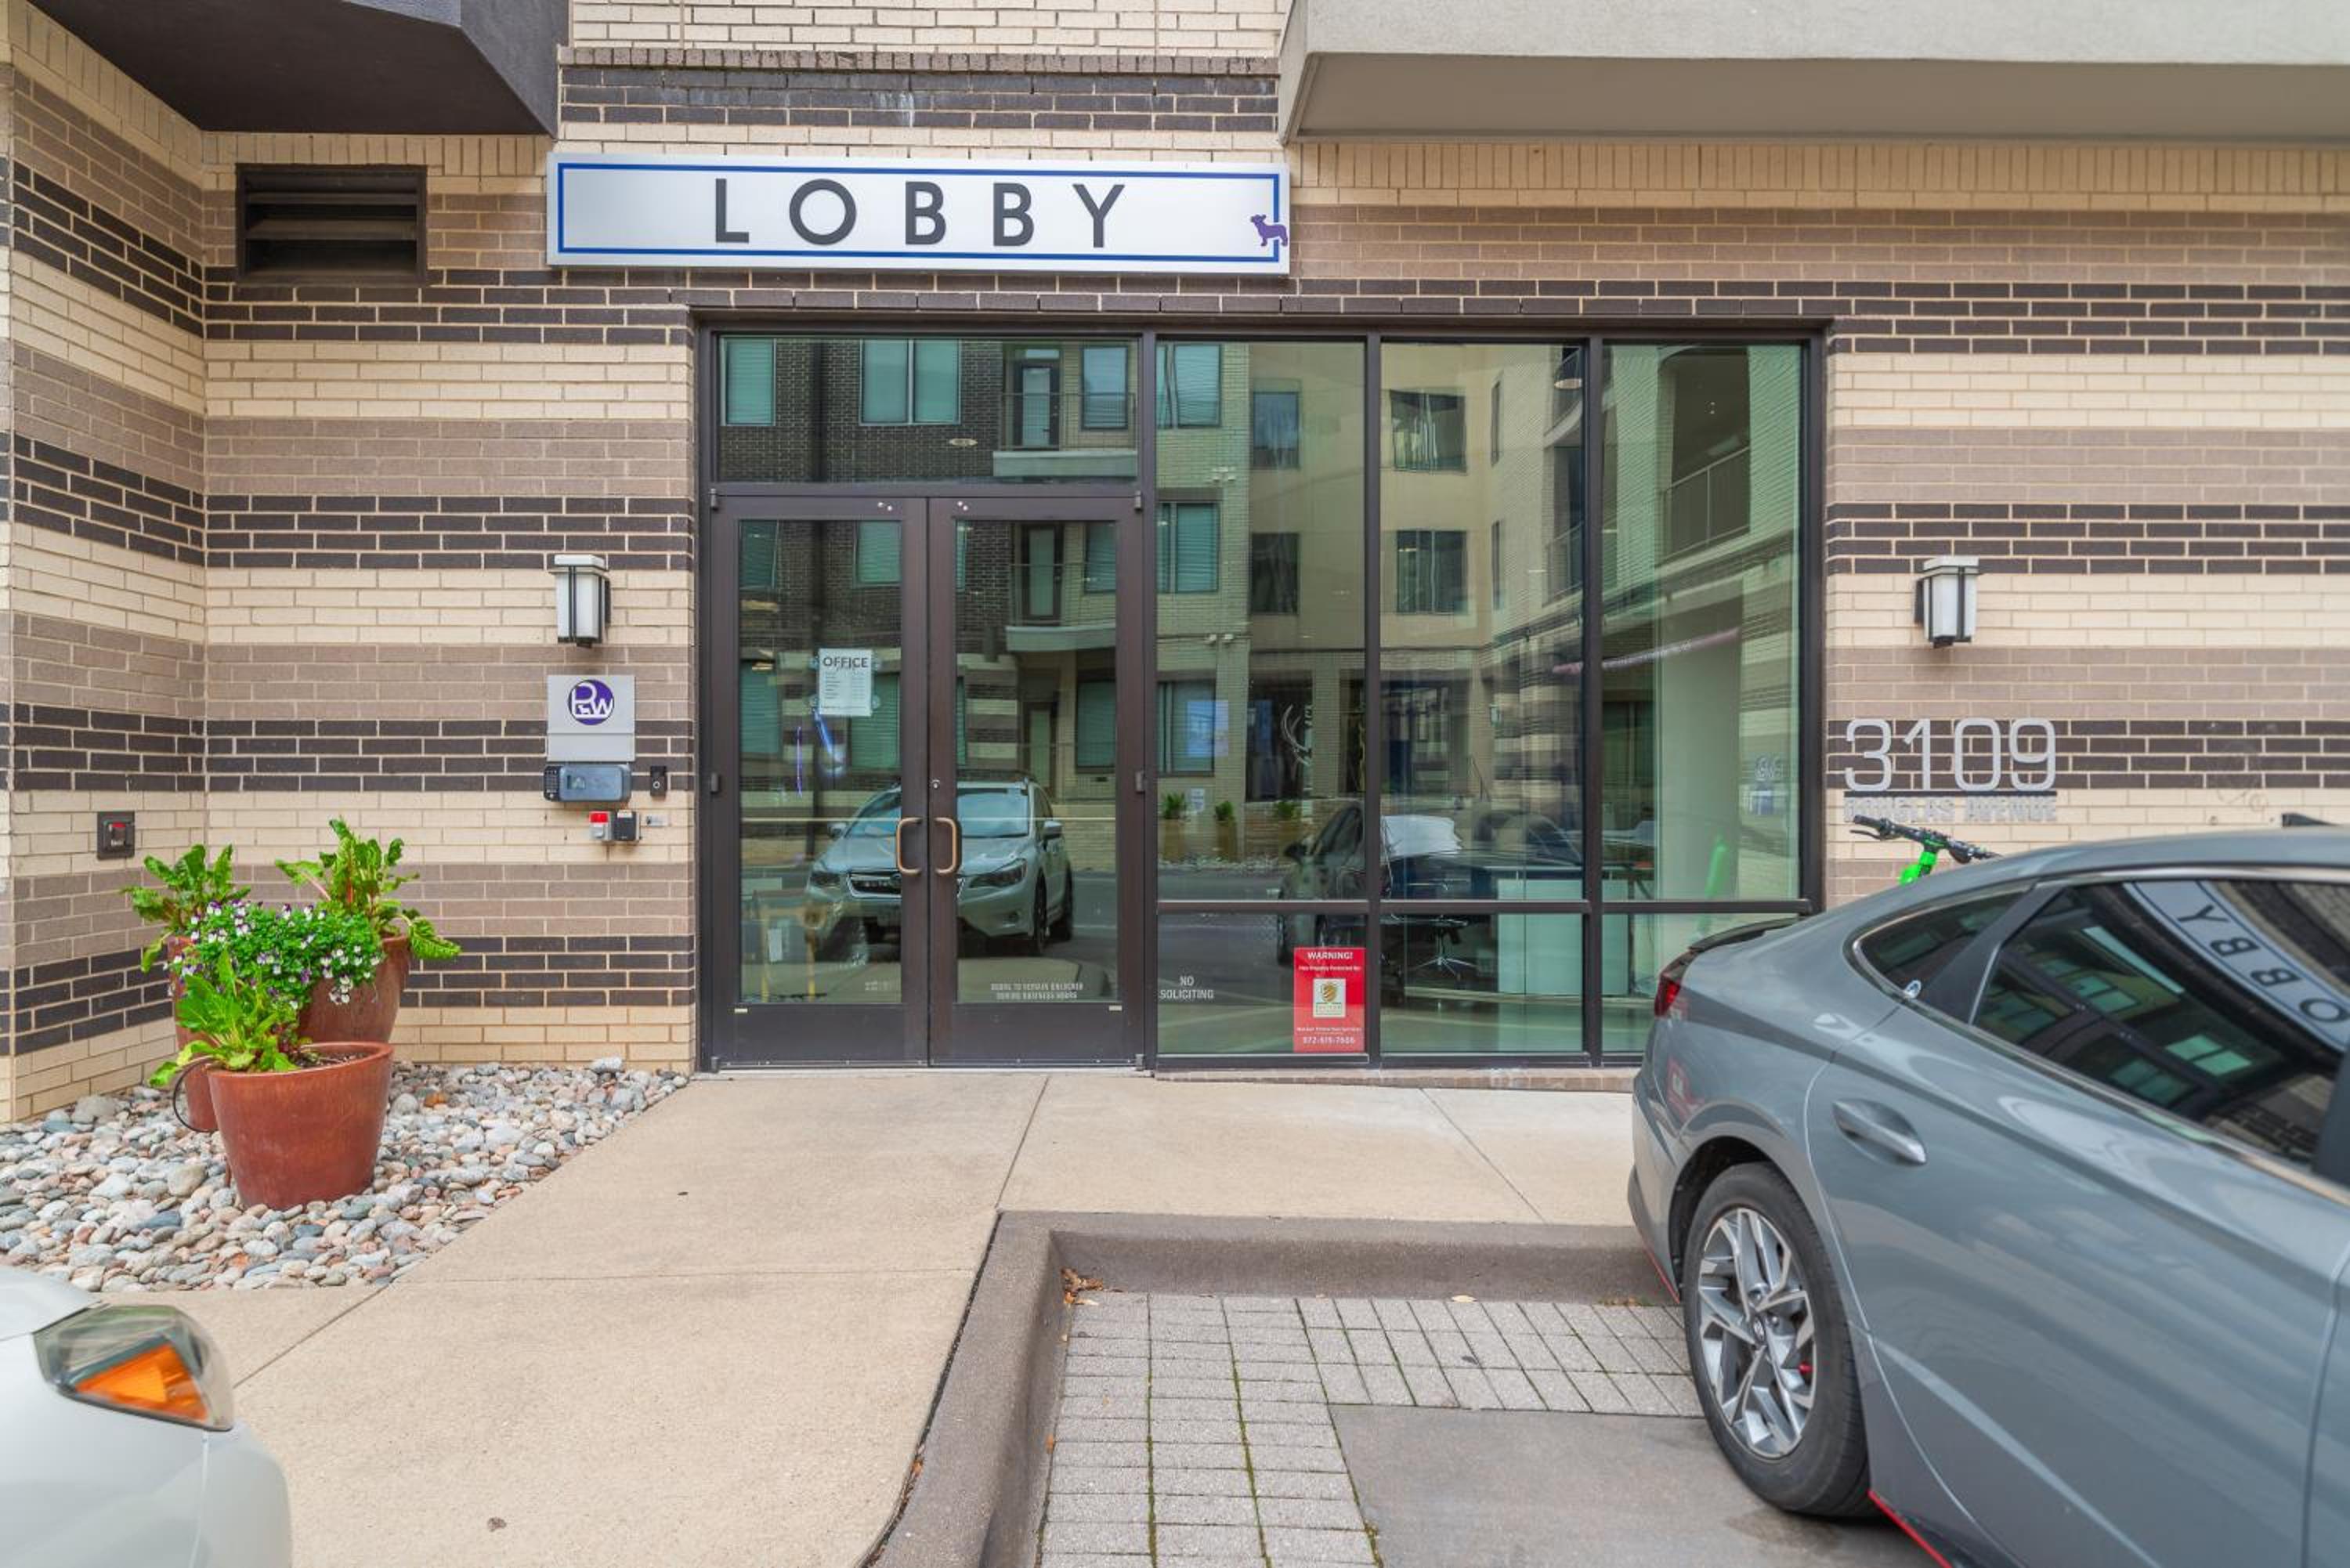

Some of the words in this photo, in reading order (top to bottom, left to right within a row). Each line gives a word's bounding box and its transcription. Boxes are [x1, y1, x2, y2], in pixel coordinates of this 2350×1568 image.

[715, 178, 1126, 248] LOBBY
[822, 657, 869, 670] OFFICE
[1845, 717, 2056, 792] 3109
[1843, 796, 1956, 823] DOUGLAS
[1965, 796, 2057, 822] AVENUE
[1180, 976, 1195, 985] NO
[1159, 989, 1214, 999] SOLICITING
